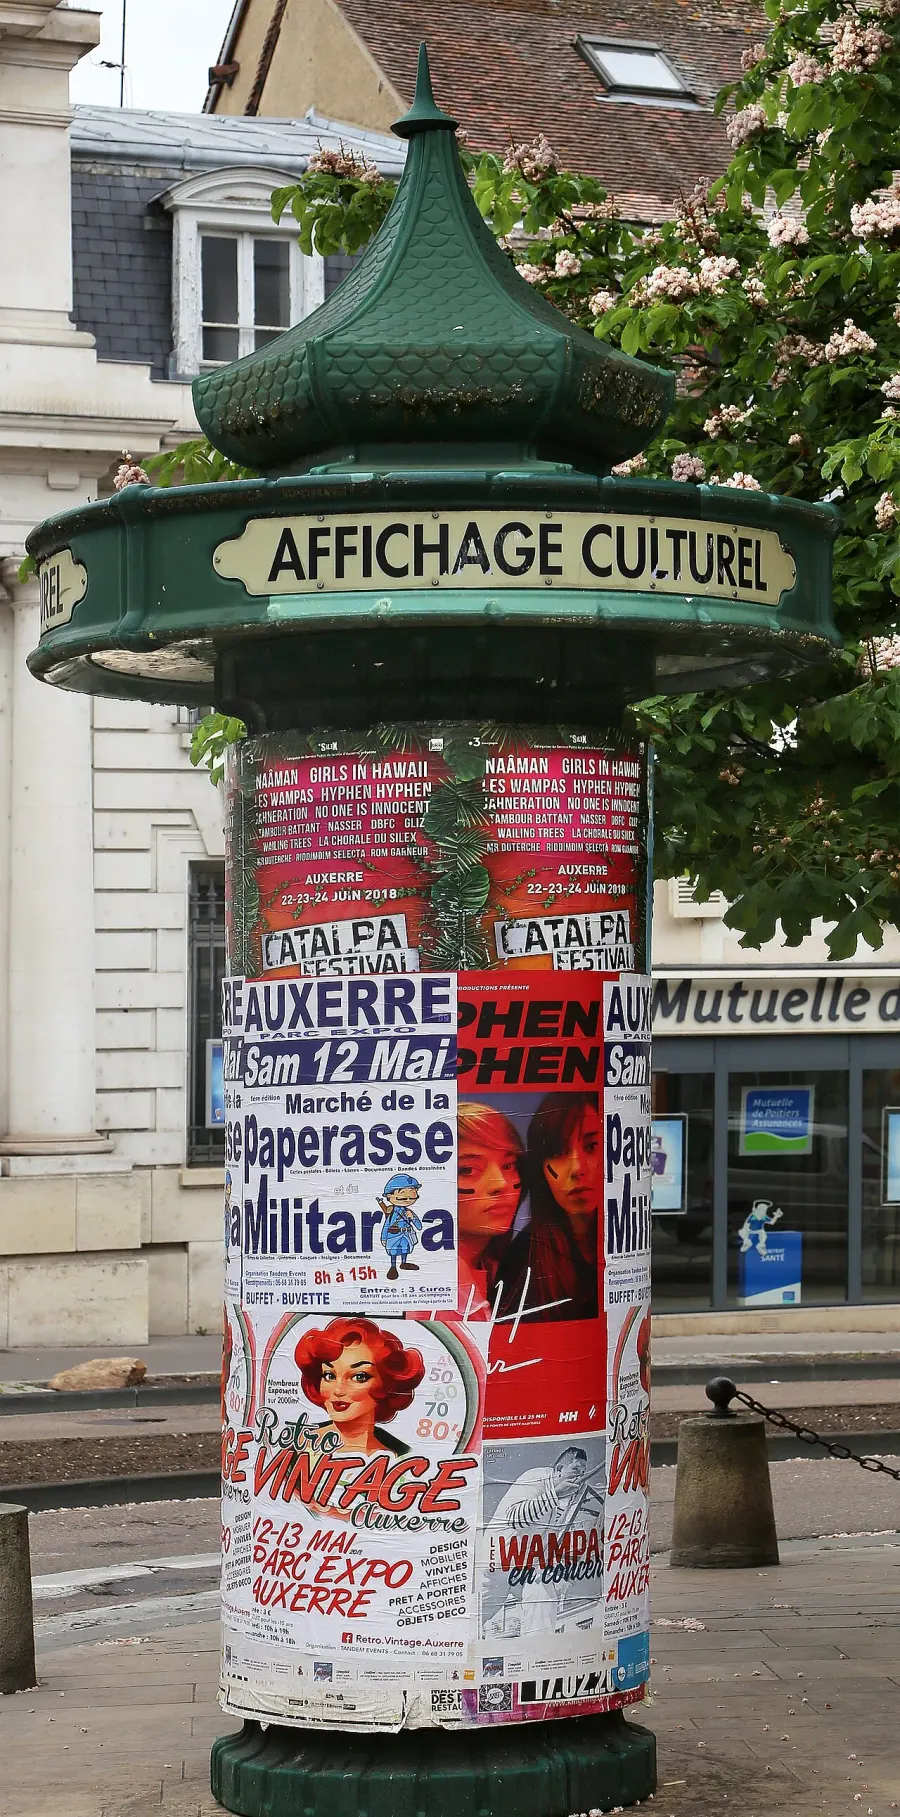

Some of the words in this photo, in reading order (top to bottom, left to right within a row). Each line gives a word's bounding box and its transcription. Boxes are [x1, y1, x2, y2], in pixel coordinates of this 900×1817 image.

[267, 521, 563, 582] AFFICHAGE
[581, 523, 767, 592] CULTUREL
[485, 754, 548, 774] NAÂMAN
[562, 757, 595, 775] GIRLS
[598, 759, 609, 776] IN
[256, 769, 298, 789] NAÂMAN
[310, 764, 348, 783] GIRLS
[352, 763, 367, 780] IN
[372, 760, 428, 779] HAWAII
[270, 788, 314, 807] WAMPAS
[321, 784, 372, 802] HYPHEN
[376, 781, 432, 799] HYPHEN
[510, 778, 566, 794] WAMPAS
[573, 778, 612, 796] HYPHEN
[315, 804, 328, 819] NO
[331, 803, 353, 817] ONE
[356, 802, 368, 816] IS
[371, 800, 431, 815] INNOCENT
[567, 797, 581, 810] NO
[583, 797, 600, 811] ONE
[602, 798, 610, 811] IS
[288, 822, 321, 836] BATTANT
[328, 819, 362, 832] NASSER
[371, 818, 395, 830] DBFC
[404, 817, 425, 828] GLIZ
[488, 813, 533, 824] TAMBOUR
[535, 813, 573, 824] BATTANT
[580, 813, 606, 825] NASSER
[289, 837, 312, 849] TREES
[318, 835, 329, 847] LA
[331, 833, 371, 846] CHORALE
[374, 832, 387, 844] DU
[389, 831, 417, 843] SILEX
[497, 827, 535, 839] WAILING
[538, 827, 565, 838] TREES
[571, 828, 580, 838] LA
[583, 828, 612, 840] CHORALE
[333, 848, 366, 859] SELECTA
[370, 848, 388, 857] ROM
[501, 842, 541, 852] DUTERCHE
[546, 842, 583, 852] RIDDIMDIM
[305, 871, 364, 886] AUXERRE
[557, 864, 608, 876] AUXERRE
[281, 890, 329, 906] 22-23-24
[331, 888, 361, 902] JUIN
[364, 888, 397, 900] 2018
[527, 882, 582, 894] 22-23-24
[584, 883, 606, 894] JUIN
[607, 884, 626, 895] 2018
[264, 917, 402, 967] CATALPA
[501, 913, 628, 955] CATALPA
[499, 983, 530, 991] PRÉSENTE
[244, 977, 452, 1033] AUXERRE
[652, 977, 871, 1024] Mutuelle
[260, 1030, 320, 1040] PARC
[330, 1026, 417, 1036] EXPO
[244, 1045, 300, 1087] Sam
[313, 1040, 359, 1082] 12
[368, 1038, 451, 1081] Mai
[606, 1044, 647, 1086] Sam
[285, 1090, 372, 1115] Marché
[381, 1089, 415, 1111] de
[424, 1088, 450, 1110] la
[752, 1098, 794, 1107] Mutuelle
[752, 1109, 762, 1118] de
[764, 1108, 800, 1118] Poitiers
[752, 1119, 803, 1128] Assurances
[314, 1270, 331, 1285] 8h
[335, 1268, 345, 1283] à
[349, 1265, 378, 1281] 15h
[246, 1291, 274, 1305] BUFFET
[282, 1292, 330, 1305] BUVETTE
[360, 1286, 397, 1294] Entrée
[608, 1289, 635, 1305] BUFFET
[267, 1379, 299, 1388] Nombreux
[428, 1367, 454, 1384] 50
[267, 1386, 298, 1395] Exposants
[433, 1384, 458, 1401] 60
[424, 1401, 449, 1418] 70
[558, 1410, 579, 1423] HH
[254, 1406, 343, 1453] Retro
[253, 1446, 479, 1513] VINTAGE
[607, 1507, 643, 1542] 12-13
[253, 1516, 304, 1549] 12-13
[306, 1529, 358, 1555] MAI
[429, 1538, 468, 1555] DESIGN
[498, 1527, 604, 1572] WAMPA
[606, 1533, 647, 1572] PARC
[253, 1544, 312, 1581] PARC
[313, 1555, 414, 1589] EXPO
[420, 1550, 468, 1568] MOBILIER
[425, 1561, 468, 1577] VINYLES
[508, 1564, 537, 1587] en
[419, 1572, 468, 1590] AFFICHES
[252, 1575, 377, 1618] AUXERRE
[389, 1594, 414, 1607] PRET
[416, 1593, 425, 1602] A
[426, 1584, 467, 1600] PORTER
[398, 1595, 466, 1617] ACCESSOIRES
[396, 1613, 434, 1628] OBJETS
[437, 1606, 466, 1620] DECO
[305, 1642, 336, 1651] Organisation
[340, 1645, 365, 1653] TANDEM
[366, 1647, 389, 1655] EVENTS
[356, 1634, 464, 1649] Retro.Vintage.Auxerre
[431, 1693, 455, 1705] DES
